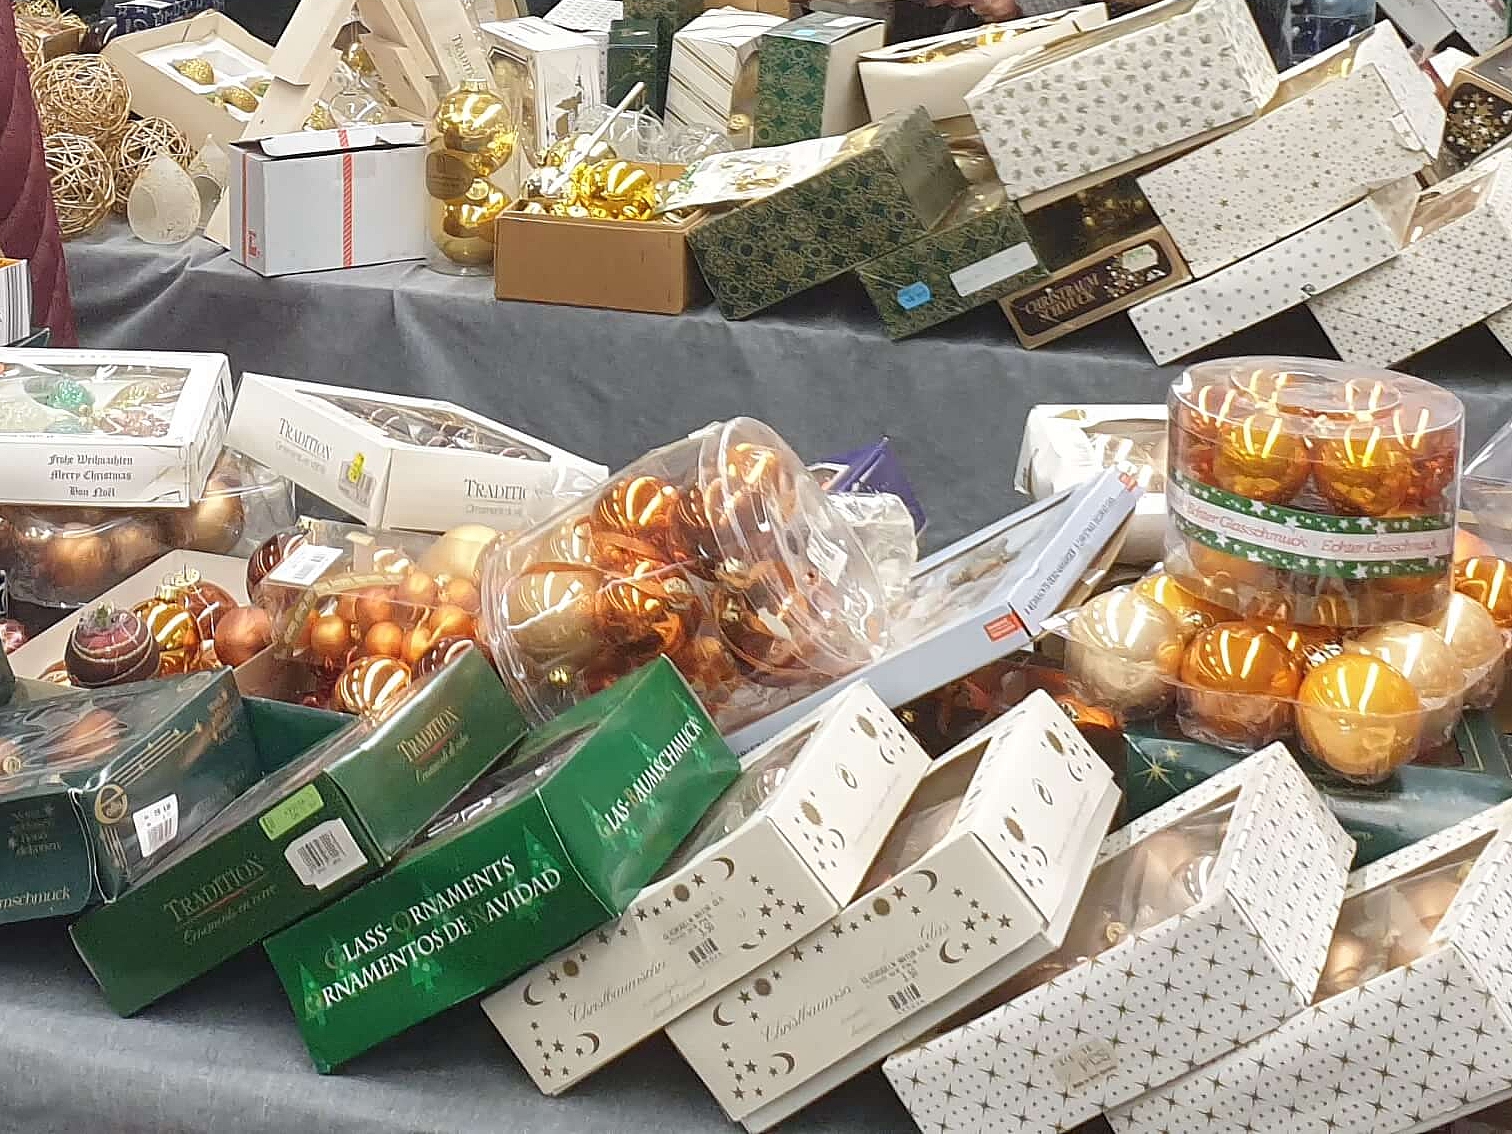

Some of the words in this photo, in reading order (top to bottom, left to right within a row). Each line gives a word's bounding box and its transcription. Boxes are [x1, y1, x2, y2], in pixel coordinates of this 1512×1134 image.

[278, 416, 334, 462] TRADITION
[49, 469, 81, 483] Merry
[82, 469, 133, 482] Christmas
[444, 914, 472, 945] DE
